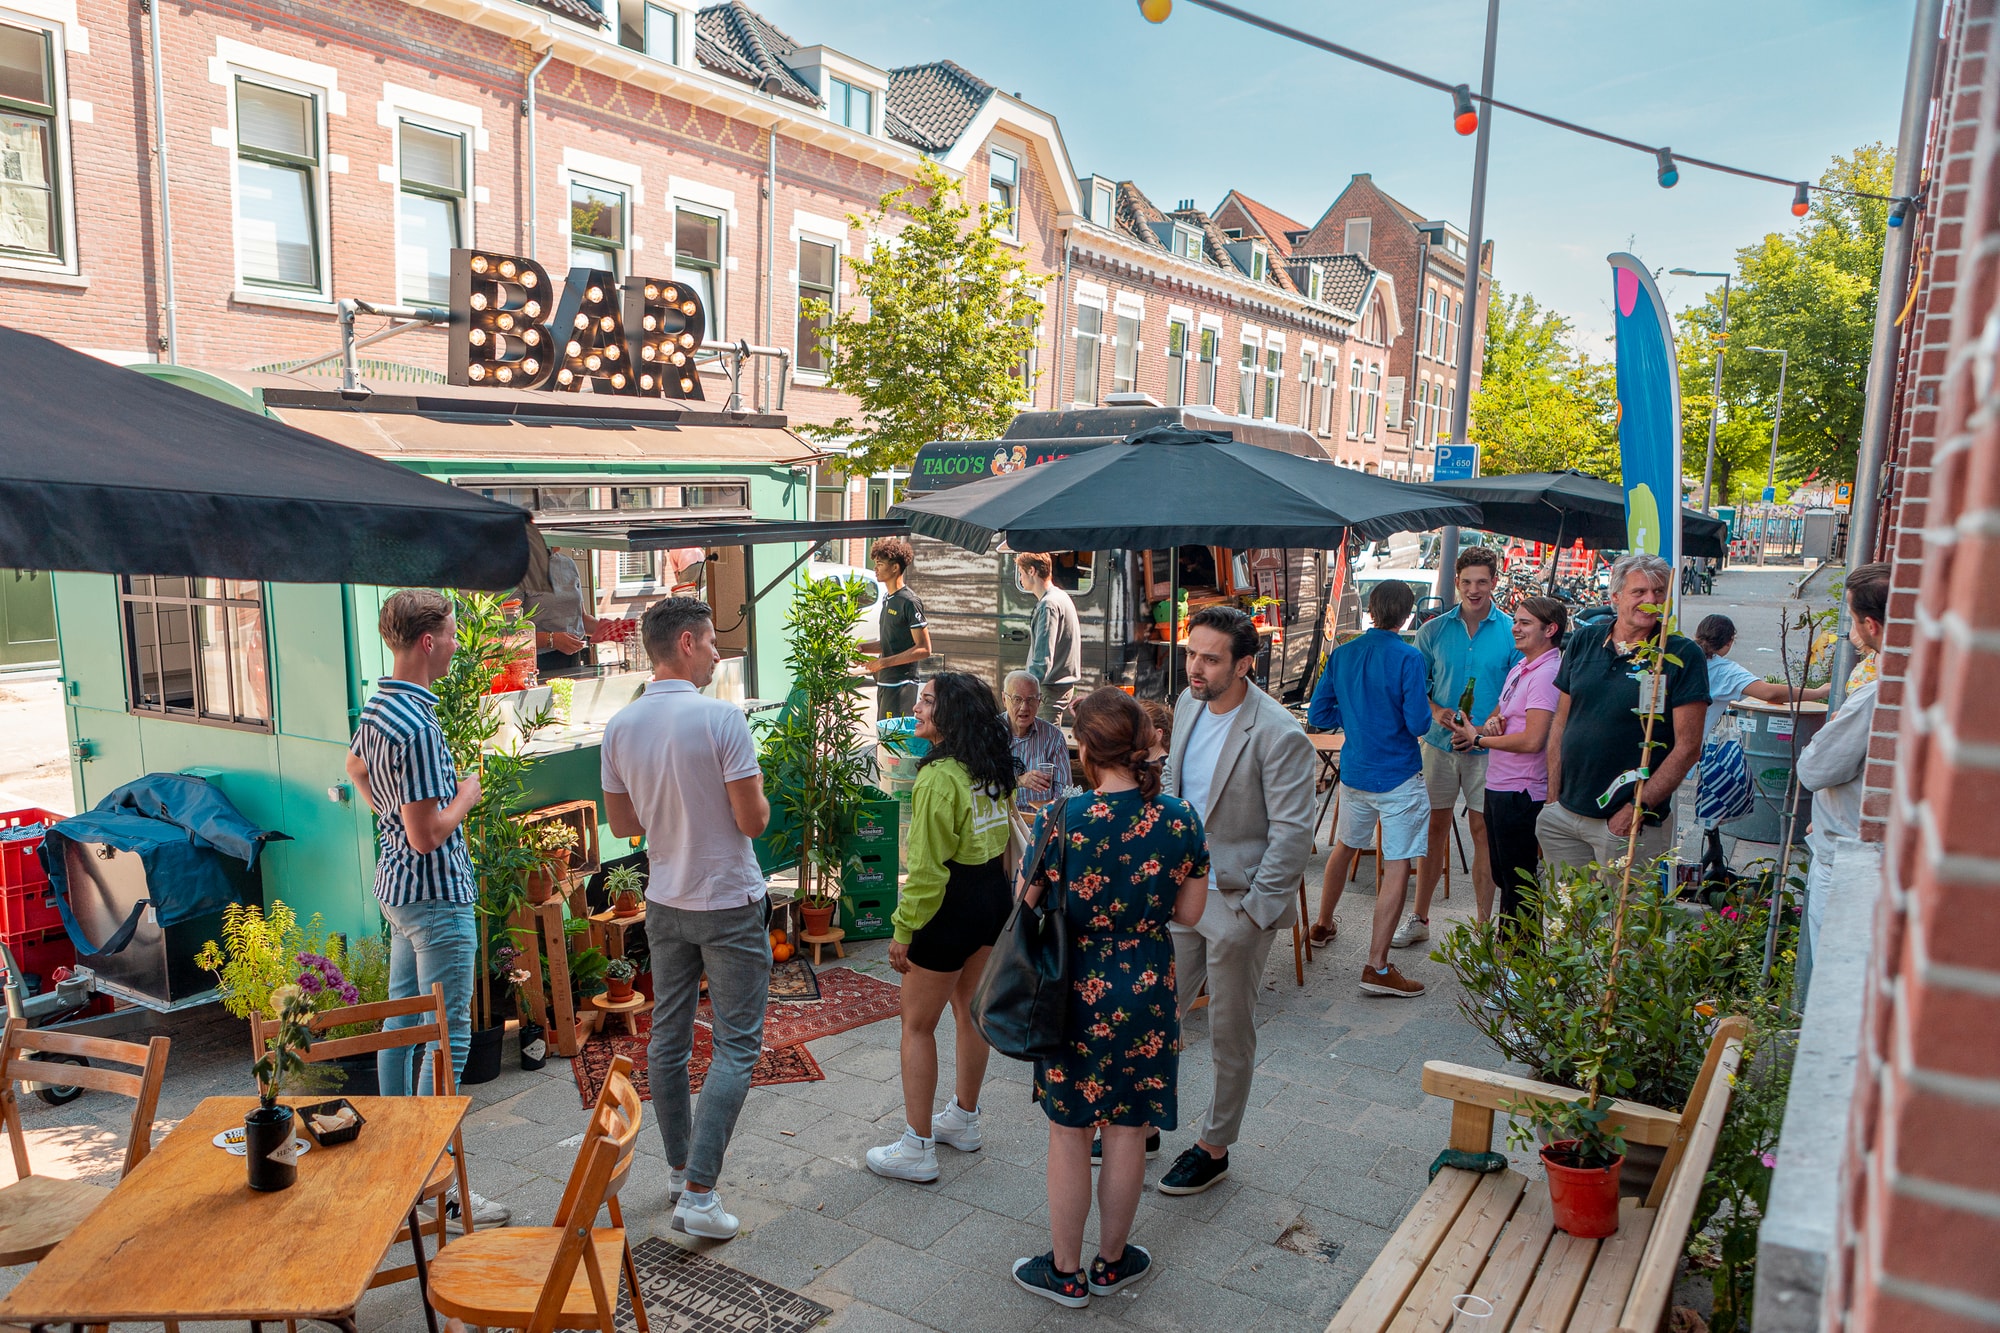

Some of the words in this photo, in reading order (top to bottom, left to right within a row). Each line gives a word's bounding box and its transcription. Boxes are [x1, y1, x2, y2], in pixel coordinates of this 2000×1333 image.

[448, 248, 706, 401] BAR
[922, 456, 986, 475] TACO'S
[1437, 448, 1451, 466] P
[781, 1299, 825, 1323] DRAIN
